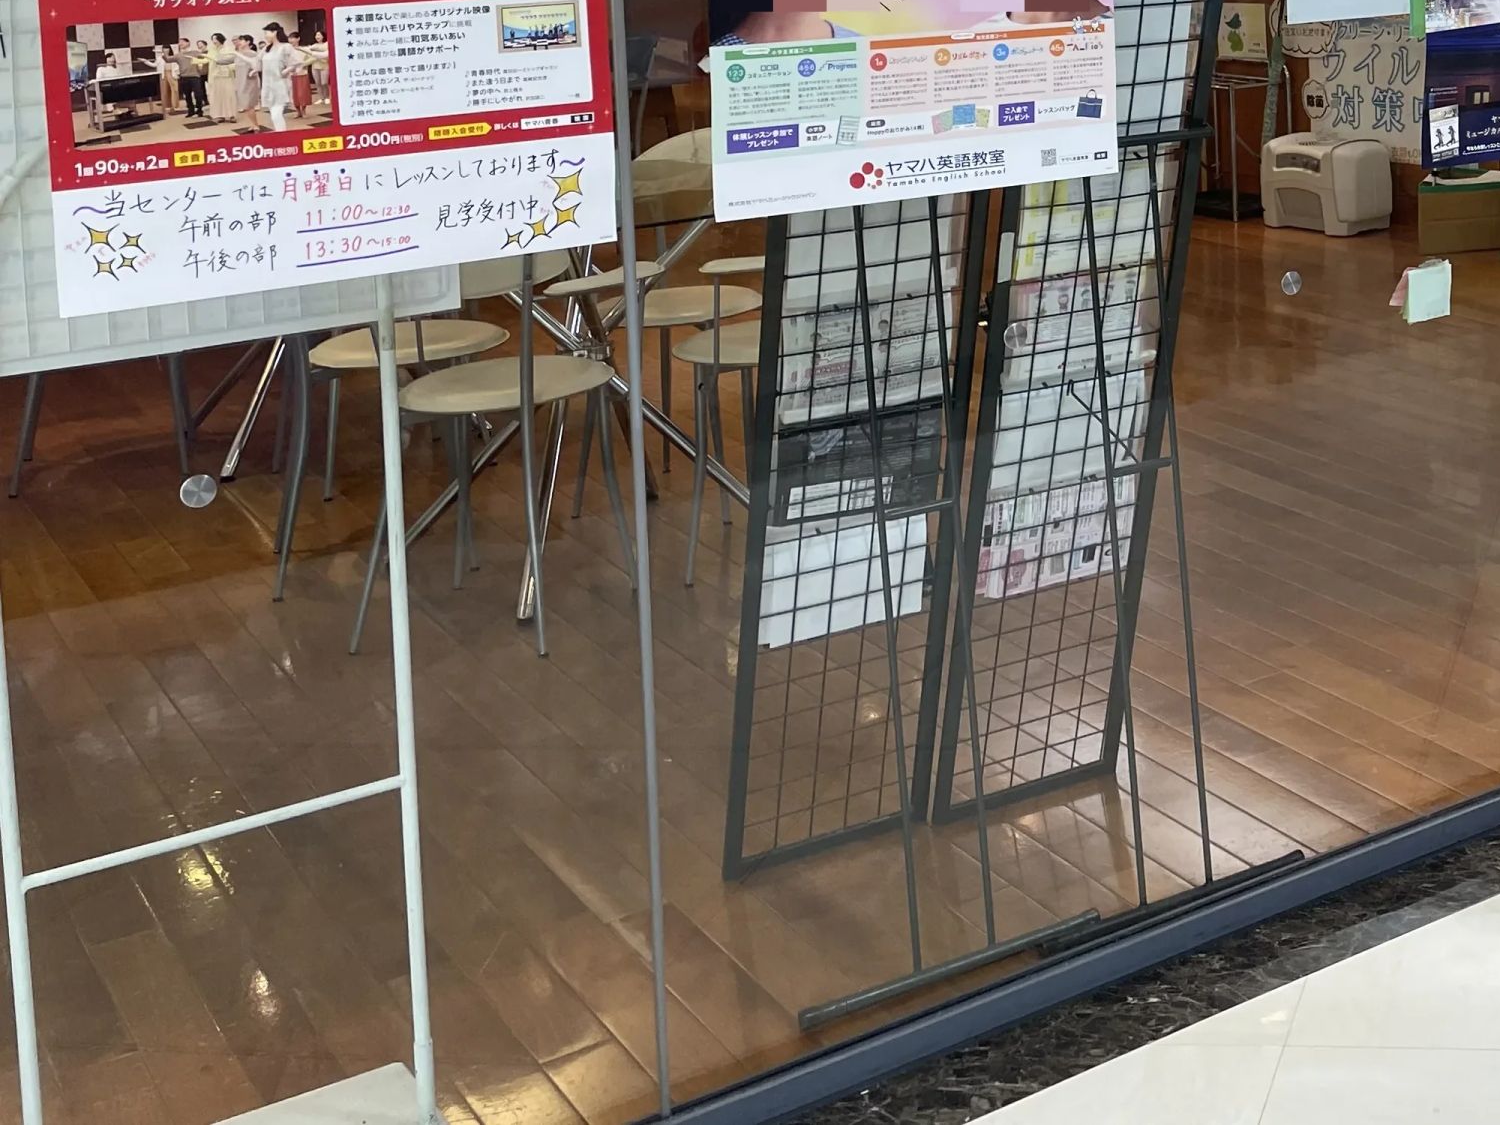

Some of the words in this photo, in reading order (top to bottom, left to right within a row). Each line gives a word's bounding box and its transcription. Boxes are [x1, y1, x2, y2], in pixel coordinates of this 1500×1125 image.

[1003, 113, 1031, 123] プレゼント
[1037, 104, 1076, 115] レッスンバッグ
[307, 138, 339, 150] 入会金
[746, 138, 779, 148] プレゼント
[886, 149, 1006, 176] ヤマハ英語教室
[887, 177, 926, 188] Yamaha
[932, 172, 968, 184] English
[974, 167, 1006, 178] School
[435, 194, 540, 232] 見学受付中
[178, 209, 277, 243] 午前の部
[183, 244, 277, 279] 午後の部
